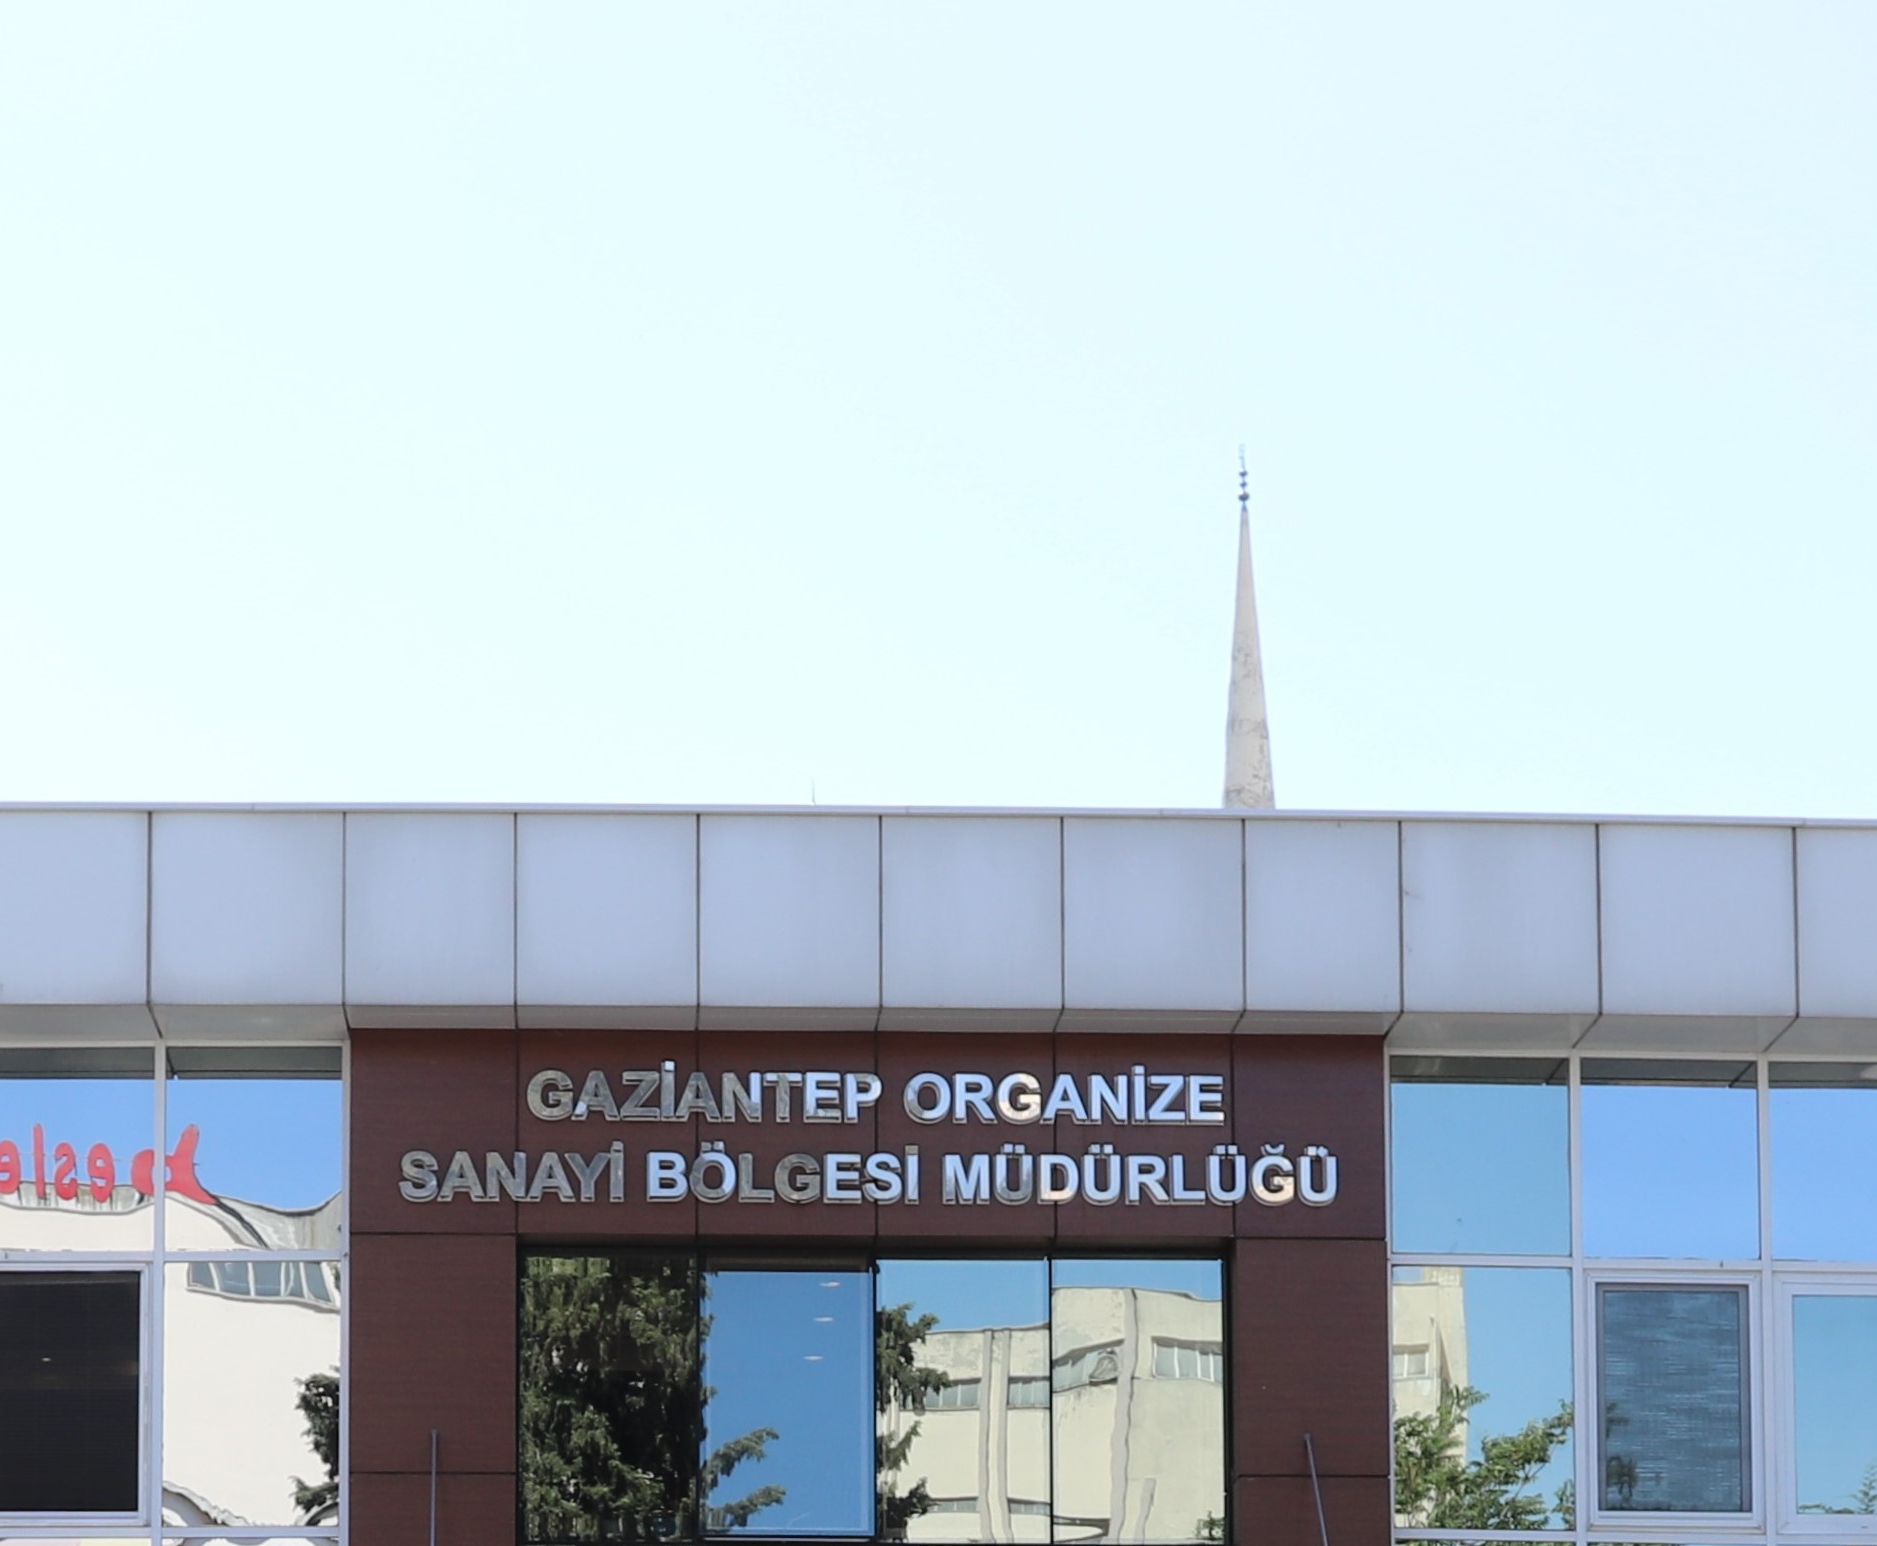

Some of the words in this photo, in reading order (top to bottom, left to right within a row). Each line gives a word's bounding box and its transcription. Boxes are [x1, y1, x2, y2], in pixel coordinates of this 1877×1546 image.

[526, 1060, 883, 1124] GAZİANTEP
[903, 1064, 1226, 1126] ORGANİZE
[399, 1140, 625, 1203] SANAYİ
[646, 1140, 920, 1206] BÖLGESİ
[942, 1142, 1340, 1207] MÜDÜRLÜĞÜ
